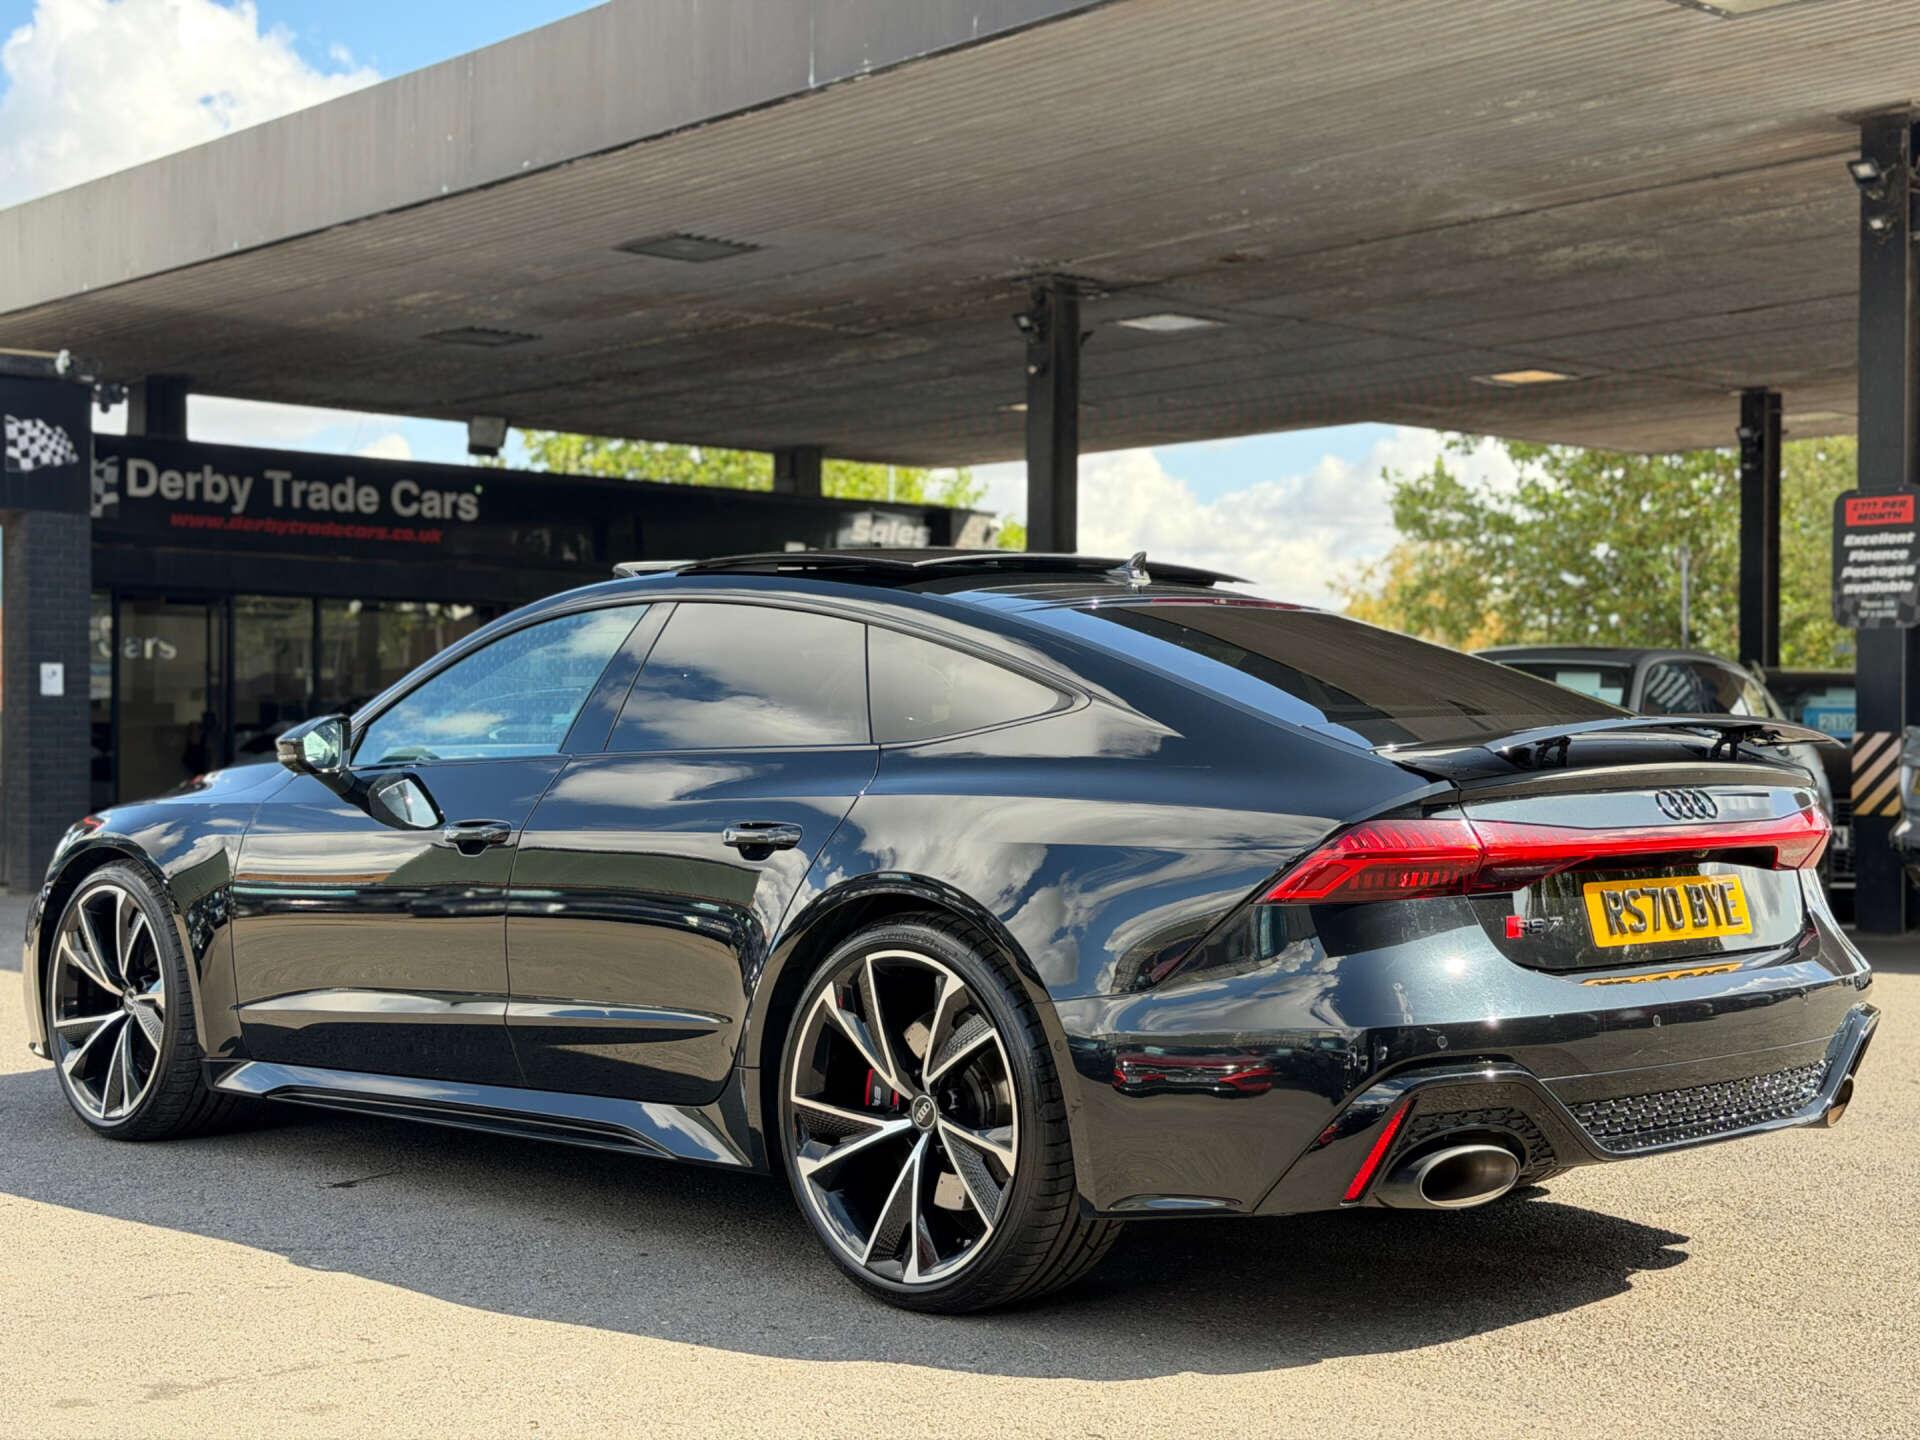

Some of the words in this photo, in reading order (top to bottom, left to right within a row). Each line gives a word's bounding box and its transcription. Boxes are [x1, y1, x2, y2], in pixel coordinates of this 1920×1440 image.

[126, 458, 253, 515] Derby
[264, 469, 380, 515] Trade
[391, 480, 479, 521] Cars
[1856, 511, 1903, 521] MONTH
[168, 512, 442, 544] www.derbytradecars.co.uk
[852, 517, 930, 548] Sales
[1843, 532, 1916, 547] Excellent
[1848, 549, 1909, 562] Finance
[1841, 565, 1917, 578] Packages
[1602, 887, 1684, 935] RS70
[1684, 882, 1743, 929] BYE
